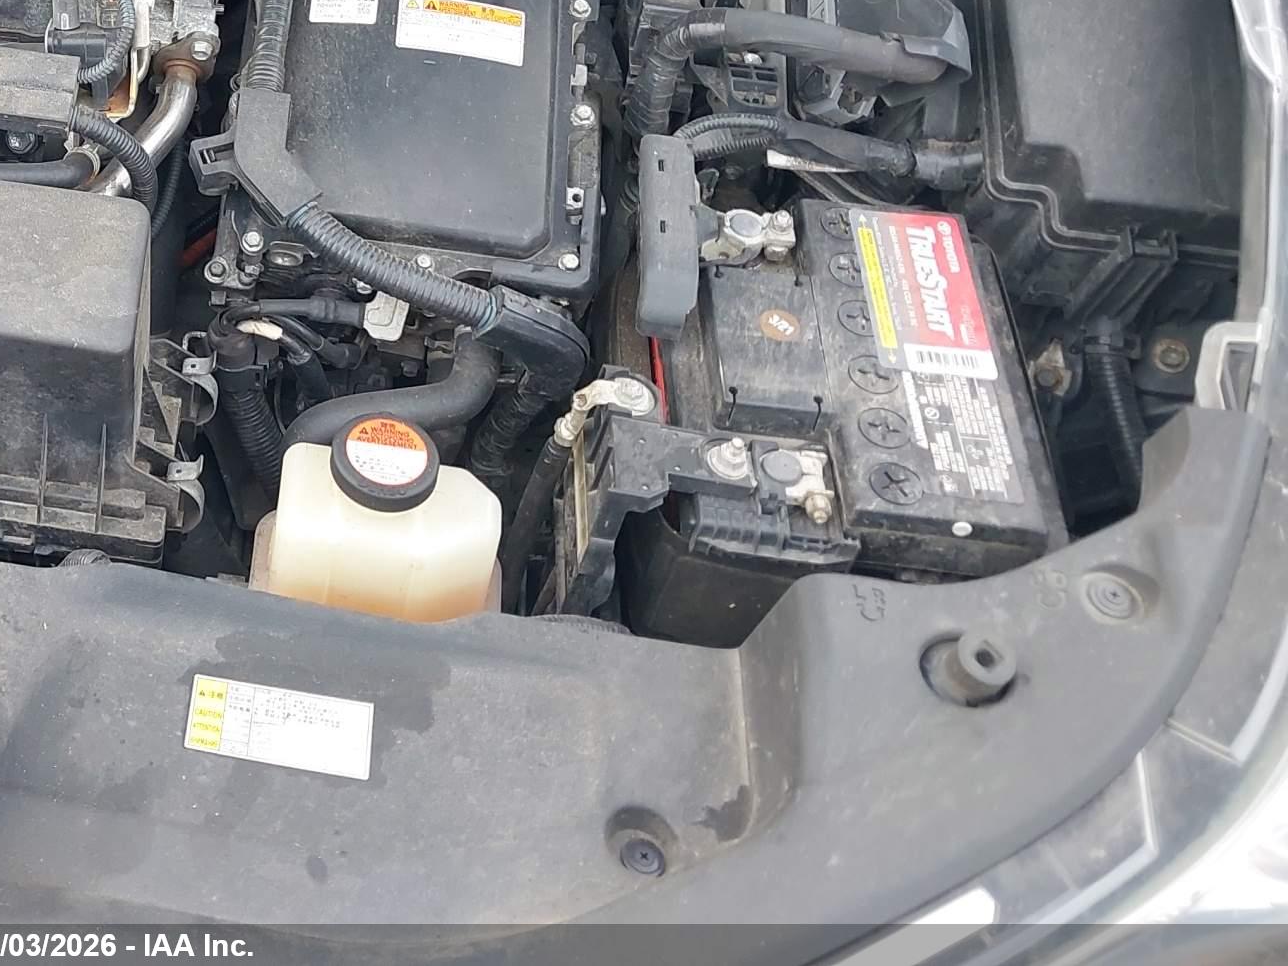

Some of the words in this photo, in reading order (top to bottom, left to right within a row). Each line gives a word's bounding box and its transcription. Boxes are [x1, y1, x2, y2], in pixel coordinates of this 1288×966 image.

[942, 234, 961, 273] TOYOTA
[370, 425, 410, 438] WARNING
[194, 708, 222, 720] CAUTION
